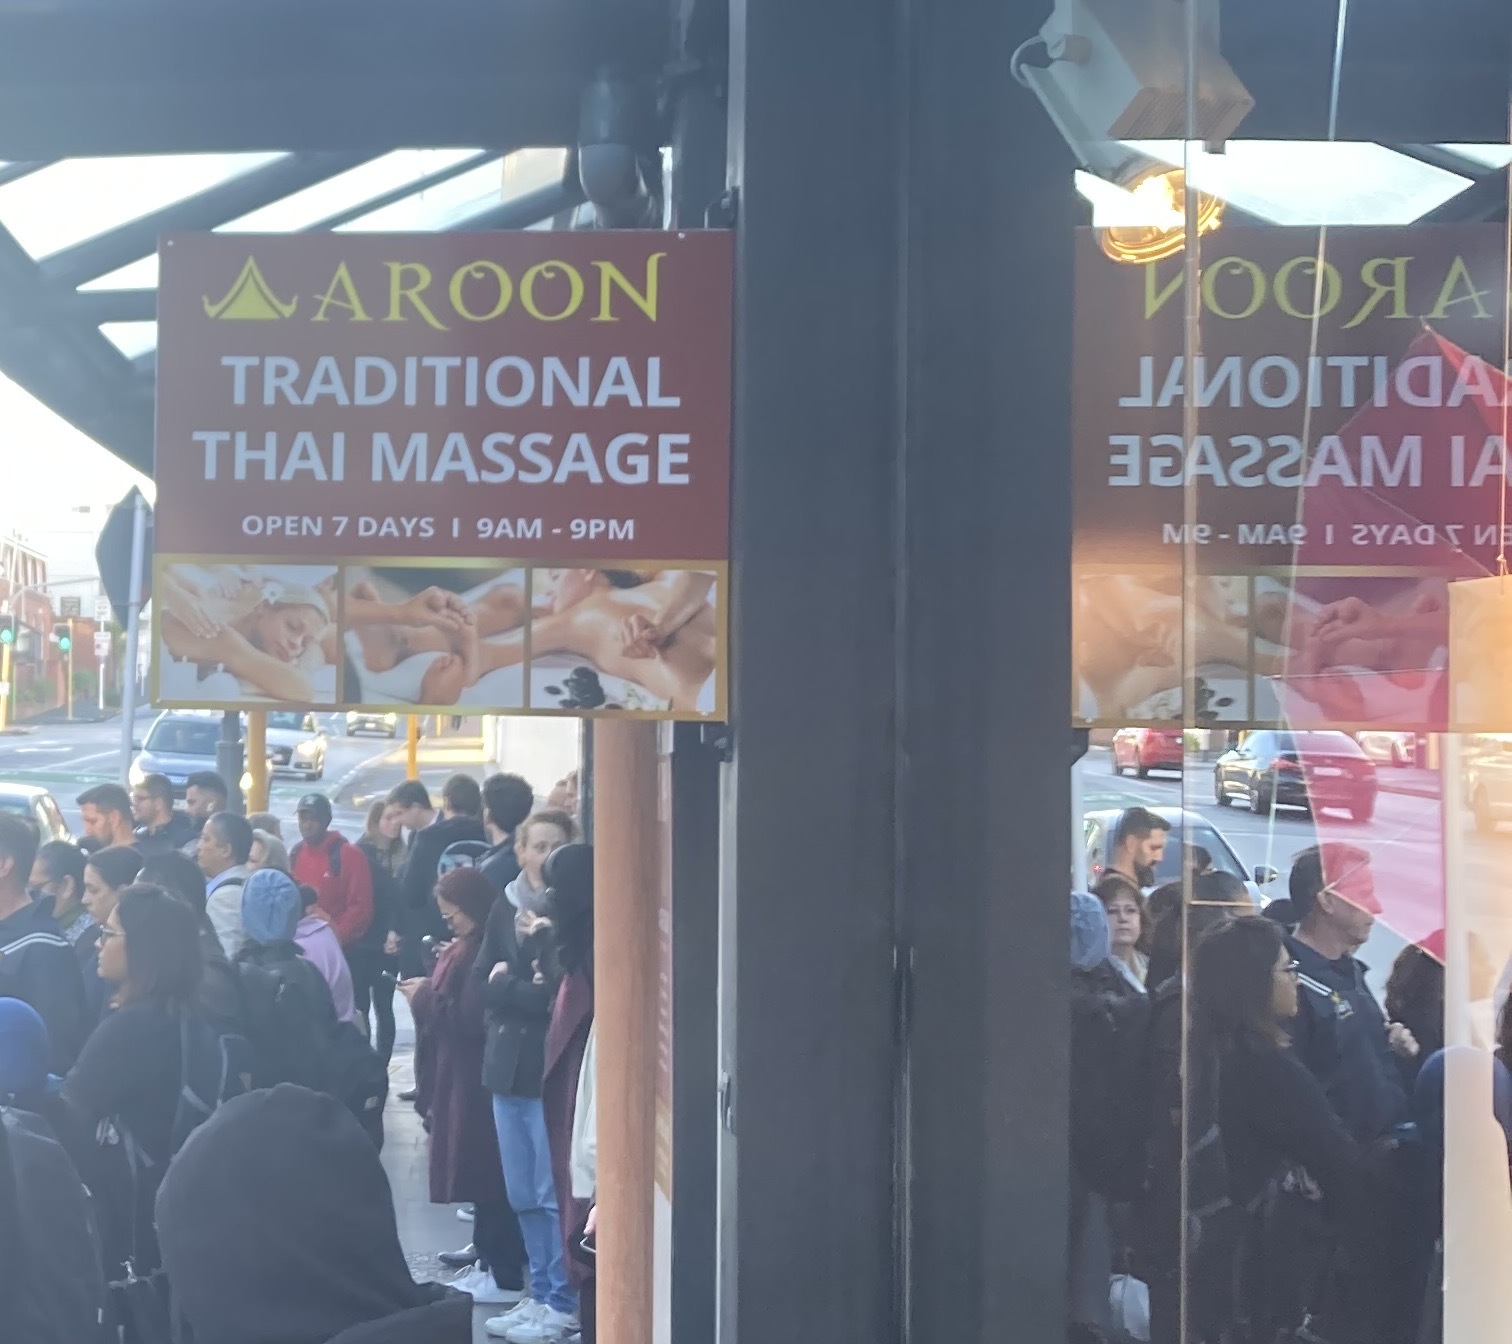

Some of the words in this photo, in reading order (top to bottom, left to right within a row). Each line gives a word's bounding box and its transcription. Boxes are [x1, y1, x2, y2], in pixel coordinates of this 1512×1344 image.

[311, 253, 667, 331] AROON
[221, 355, 681, 408] TRADITIONAL
[192, 430, 345, 482] THAI
[371, 432, 690, 485] MASSAGE
[242, 515, 323, 536] OPEN
[331, 516, 349, 537] 7
[357, 516, 435, 537] DAYS
[476, 517, 543, 539] 9AM
[570, 518, 636, 540] 9PM
